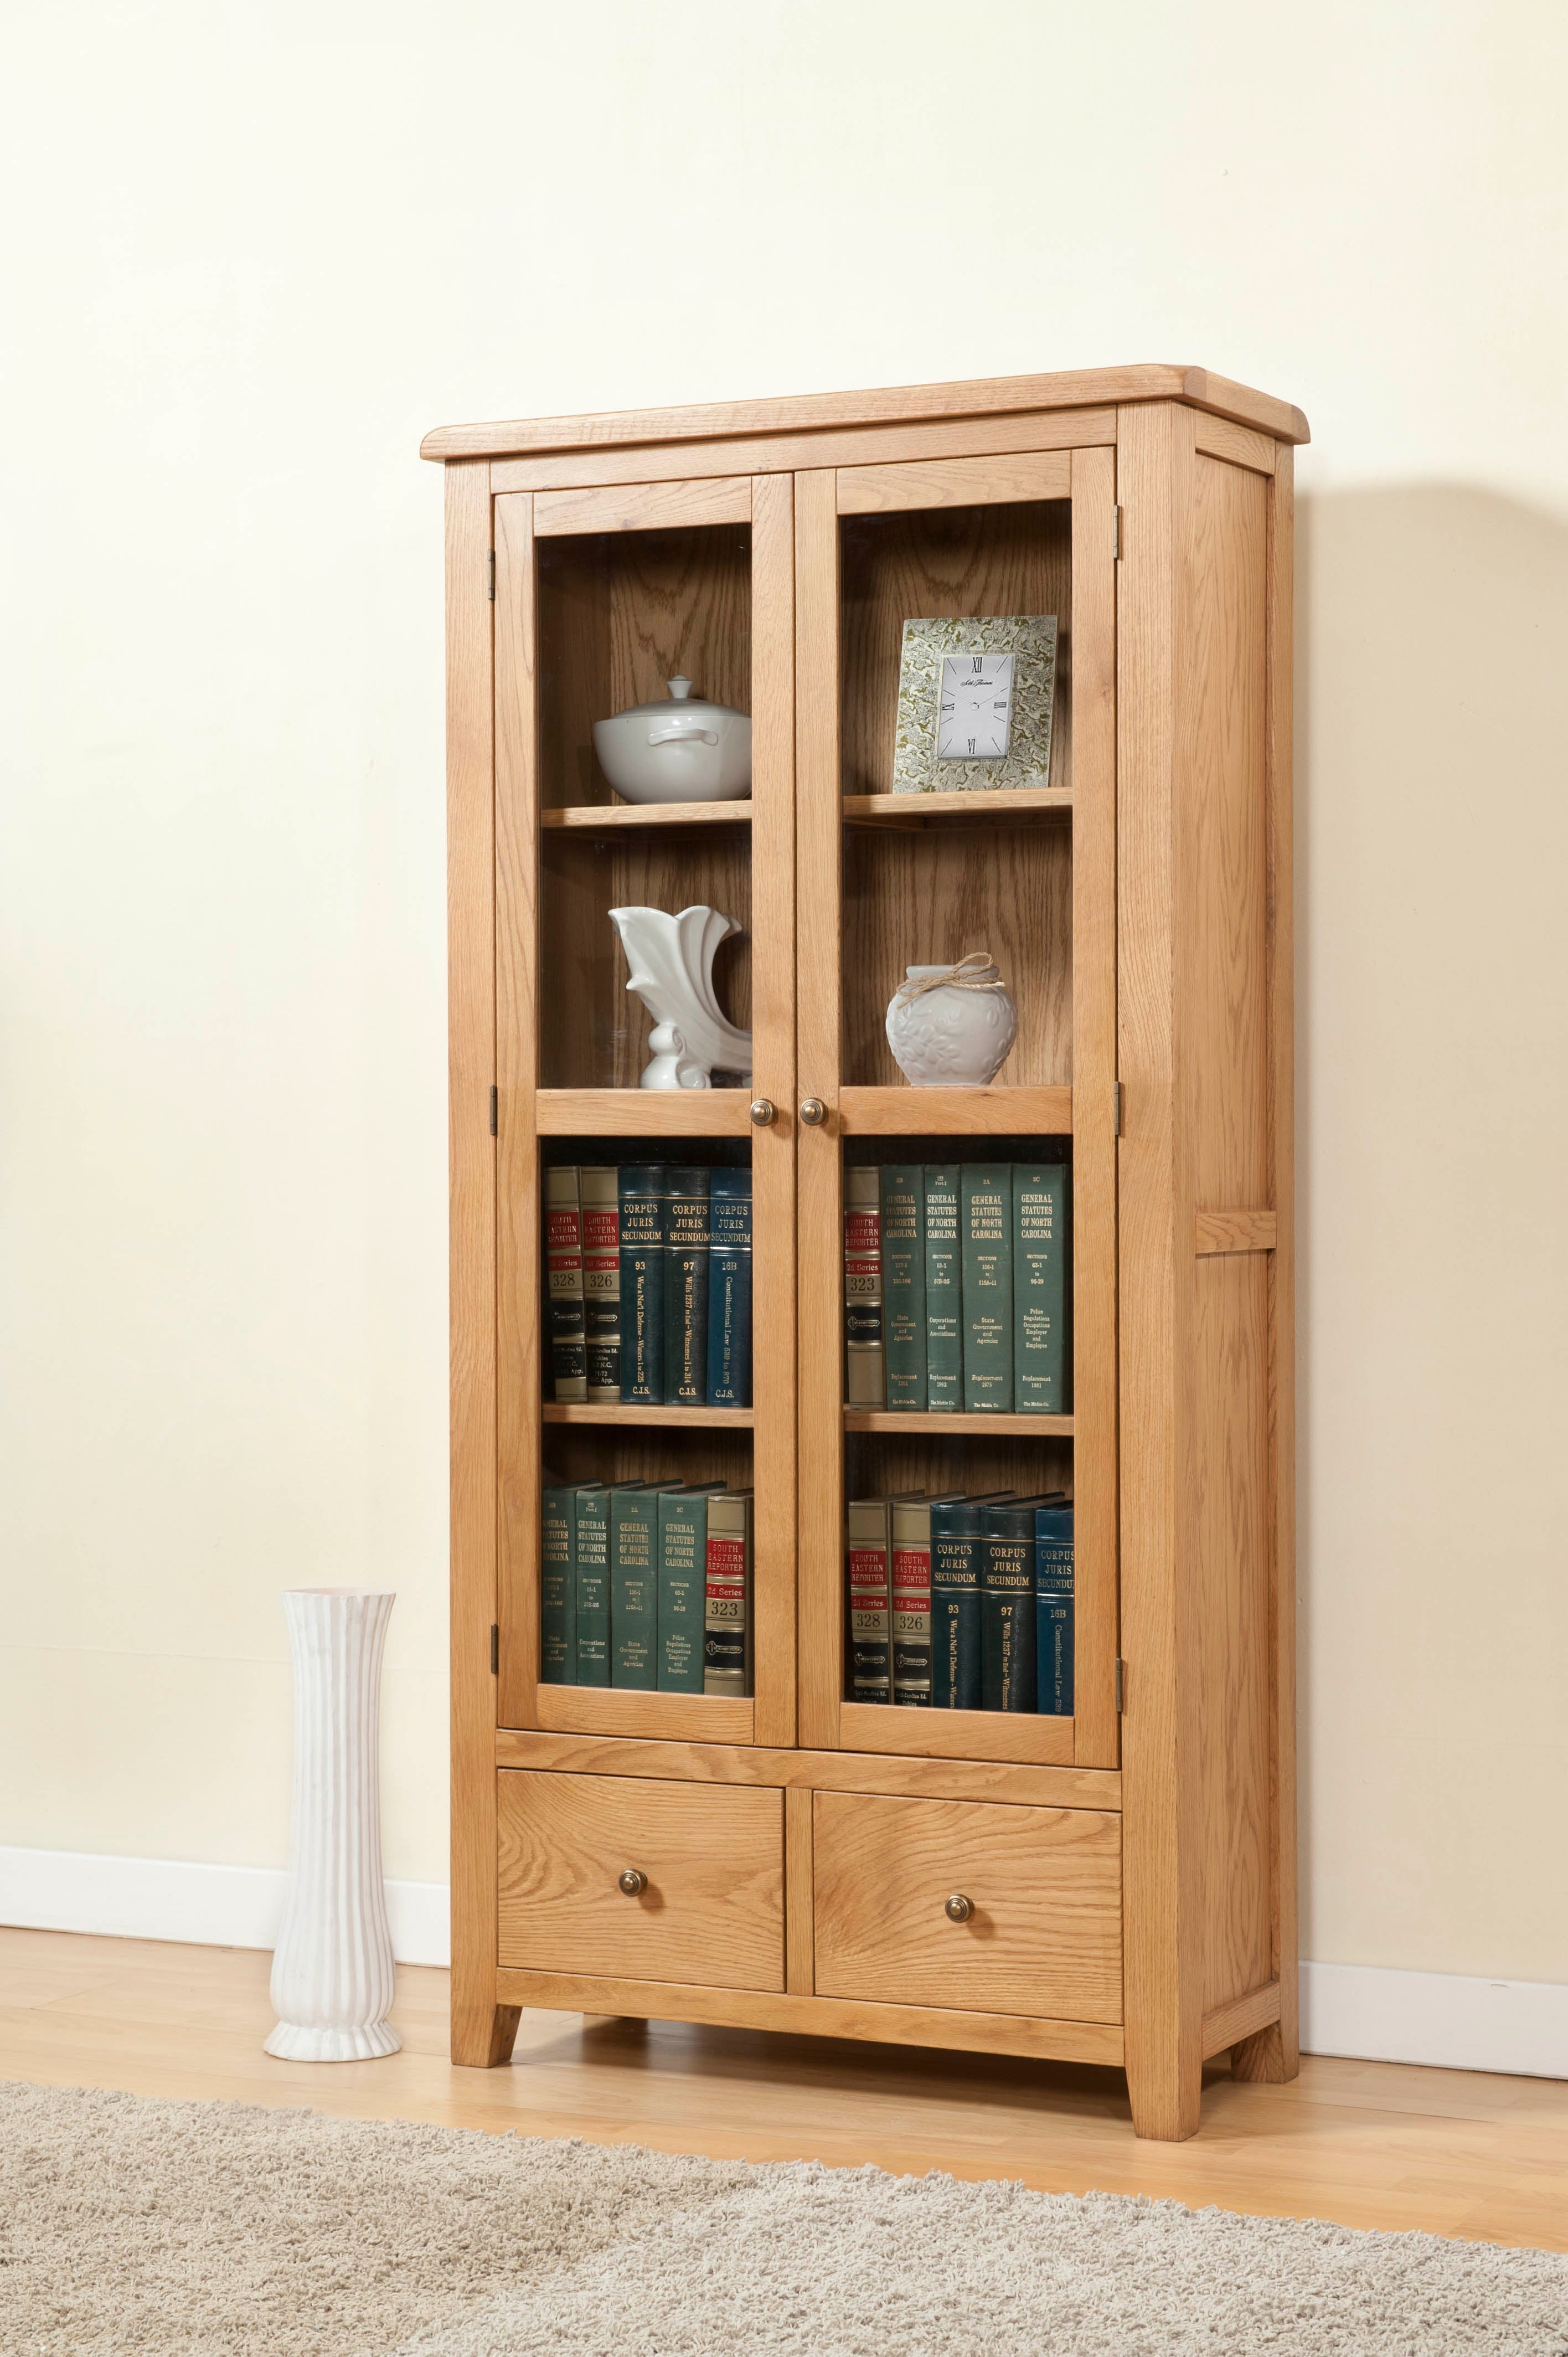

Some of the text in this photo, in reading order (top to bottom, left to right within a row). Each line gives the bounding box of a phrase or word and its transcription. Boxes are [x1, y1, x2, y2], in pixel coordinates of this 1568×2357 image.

[972, 657, 982, 673] XII
[927, 1195, 957, 1203] GENERAL
[972, 1196, 1002, 1205] GENERAL
[625, 1204, 658, 1213] CORPUS
[673, 1205, 708, 1214] CORPUS
[715, 1206, 748, 1215] CORPUS
[972, 1207, 1002, 1216] STATUTES
[1022, 1206, 1052, 1214] STATUTES
[627, 1218, 653, 1227] JURIS
[676, 1219, 703, 1228] JURIS
[718, 1219, 744, 1229] JURIS
[927, 1218, 957, 1227] OF NORTH
[982, 1219, 1002, 1227] NORTH
[622, 1231, 662, 1240] SECUNDUM
[669, 1232, 710, 1241] SECUNDUM
[711, 1232, 751, 1243] SECUNDUM
[927, 1230, 957, 1238] CAROLINA
[972, 1230, 1002, 1238] CAROLINA
[1022, 1230, 1052, 1238] CAROLINA
[635, 1262, 646, 1270] 93
[683, 1262, 694, 1270] 97
[722, 1262, 737, 1270] 16B
[554, 1273, 575, 1286] 328
[590, 1274, 612, 1288] 326
[851, 1278, 875, 1291] 323
[579, 1520, 606, 1529] GENERAL
[620, 1523, 649, 1532] GENERAL
[666, 1524, 694, 1533] GENERAL
[579, 1532, 606, 1541] STATUTES
[620, 1534, 648, 1543] STATUTES
[666, 1535, 694, 1545] STATUTES
[620, 1545, 649, 1554] OF NORTH
[666, 1546, 694, 1556] OF NORTH
[713, 1544, 738, 1553] SOUTH
[937, 1544, 972, 1555] CORPUS
[990, 1547, 1025, 1558] CORPUS
[579, 1554, 606, 1563] CAROLINA
[708, 1553, 744, 1562] EASTERN
[1041, 1550, 1074, 1560] CORPUS
[620, 1556, 649, 1565] CAROLINA
[666, 1558, 694, 1567] CAROLINA
[900, 1556, 922, 1564] SOUTH
[941, 1560, 967, 1569] JURIS
[708, 1562, 744, 1571] REPORTER
[895, 1565, 927, 1573] EASTERN
[993, 1562, 1021, 1572] JURIS
[1045, 1565, 1072, 1574] JURIS
[895, 1575, 927, 1583] REPORTER
[935, 1572, 976, 1583] SECUNDUM
[987, 1576, 1029, 1586] SECUNDUM
[1038, 1579, 1074, 1589] SECUNDU
[711, 1601, 737, 1616] 323
[906, 1601, 926, 1609] Series
[948, 1605, 959, 1614] 93
[1001, 1607, 1012, 1616] 97
[1050, 1609, 1066, 1618] 16B
[857, 1614, 880, 1627] 328
[900, 1616, 922, 1630] 326
[1002, 1677, 1010, 1710] Witnesses
